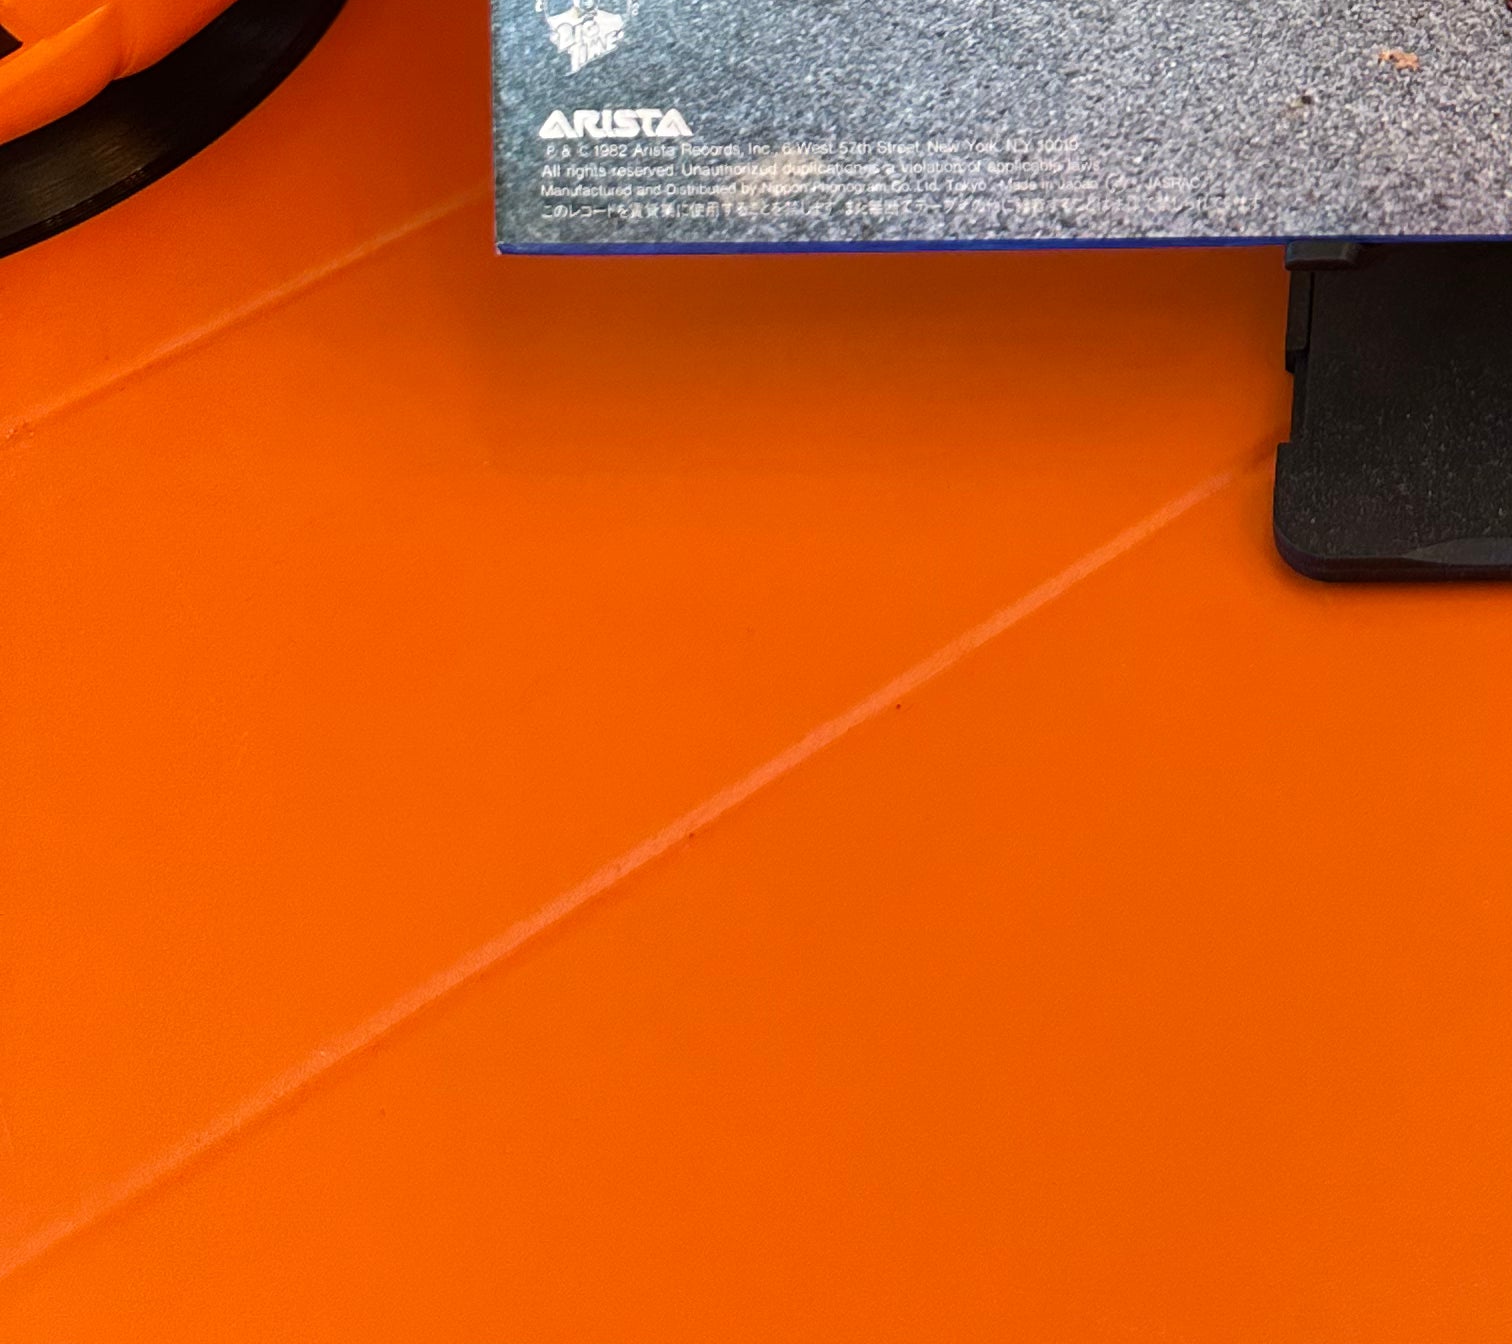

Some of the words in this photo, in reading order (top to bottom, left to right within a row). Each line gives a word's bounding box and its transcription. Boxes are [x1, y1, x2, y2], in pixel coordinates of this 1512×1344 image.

[538, 108, 694, 139] ARISTA
[594, 143, 629, 158] 1982
[632, 143, 676, 158] Arista
[796, 142, 835, 156] West
[838, 140, 873, 155] 57th
[927, 140, 960, 154] New
[541, 164, 561, 177] All
[566, 164, 607, 180] rights
[541, 184, 632, 198] Manufactured
[636, 184, 661, 197] and
[666, 183, 736, 197] Distributed
